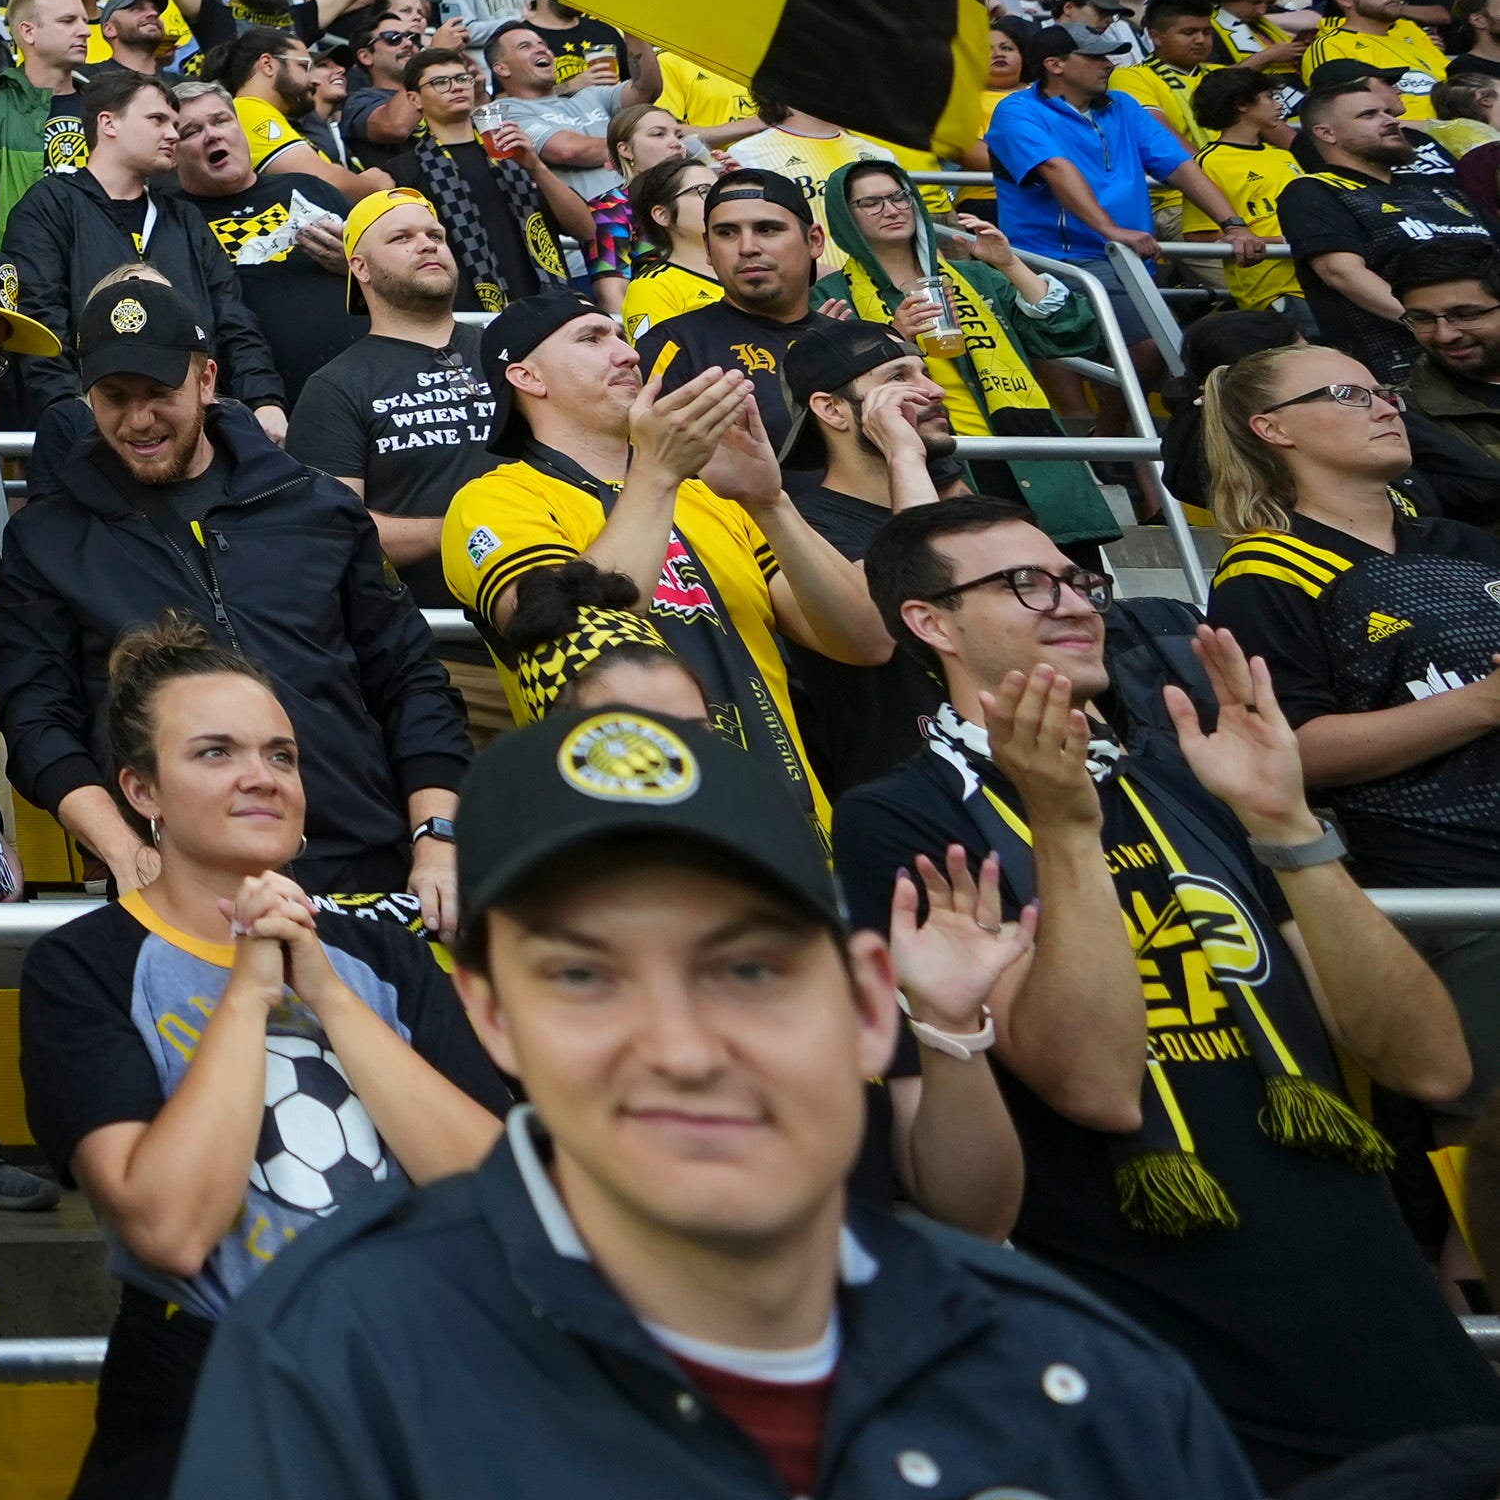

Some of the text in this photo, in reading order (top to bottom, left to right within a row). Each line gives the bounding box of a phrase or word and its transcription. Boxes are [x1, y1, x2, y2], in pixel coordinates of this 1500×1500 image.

[58, 141, 73, 157] 96
[371, 382, 492, 414] STANDING
[981, 375, 1028, 394] CREW
[391, 405, 469, 428] WHEN
[375, 426, 462, 454] PLANE
[1367, 618, 1413, 644] adidas
[1140, 949, 1230, 1027] EA
[1148, 1025, 1251, 1062] COLUMB
